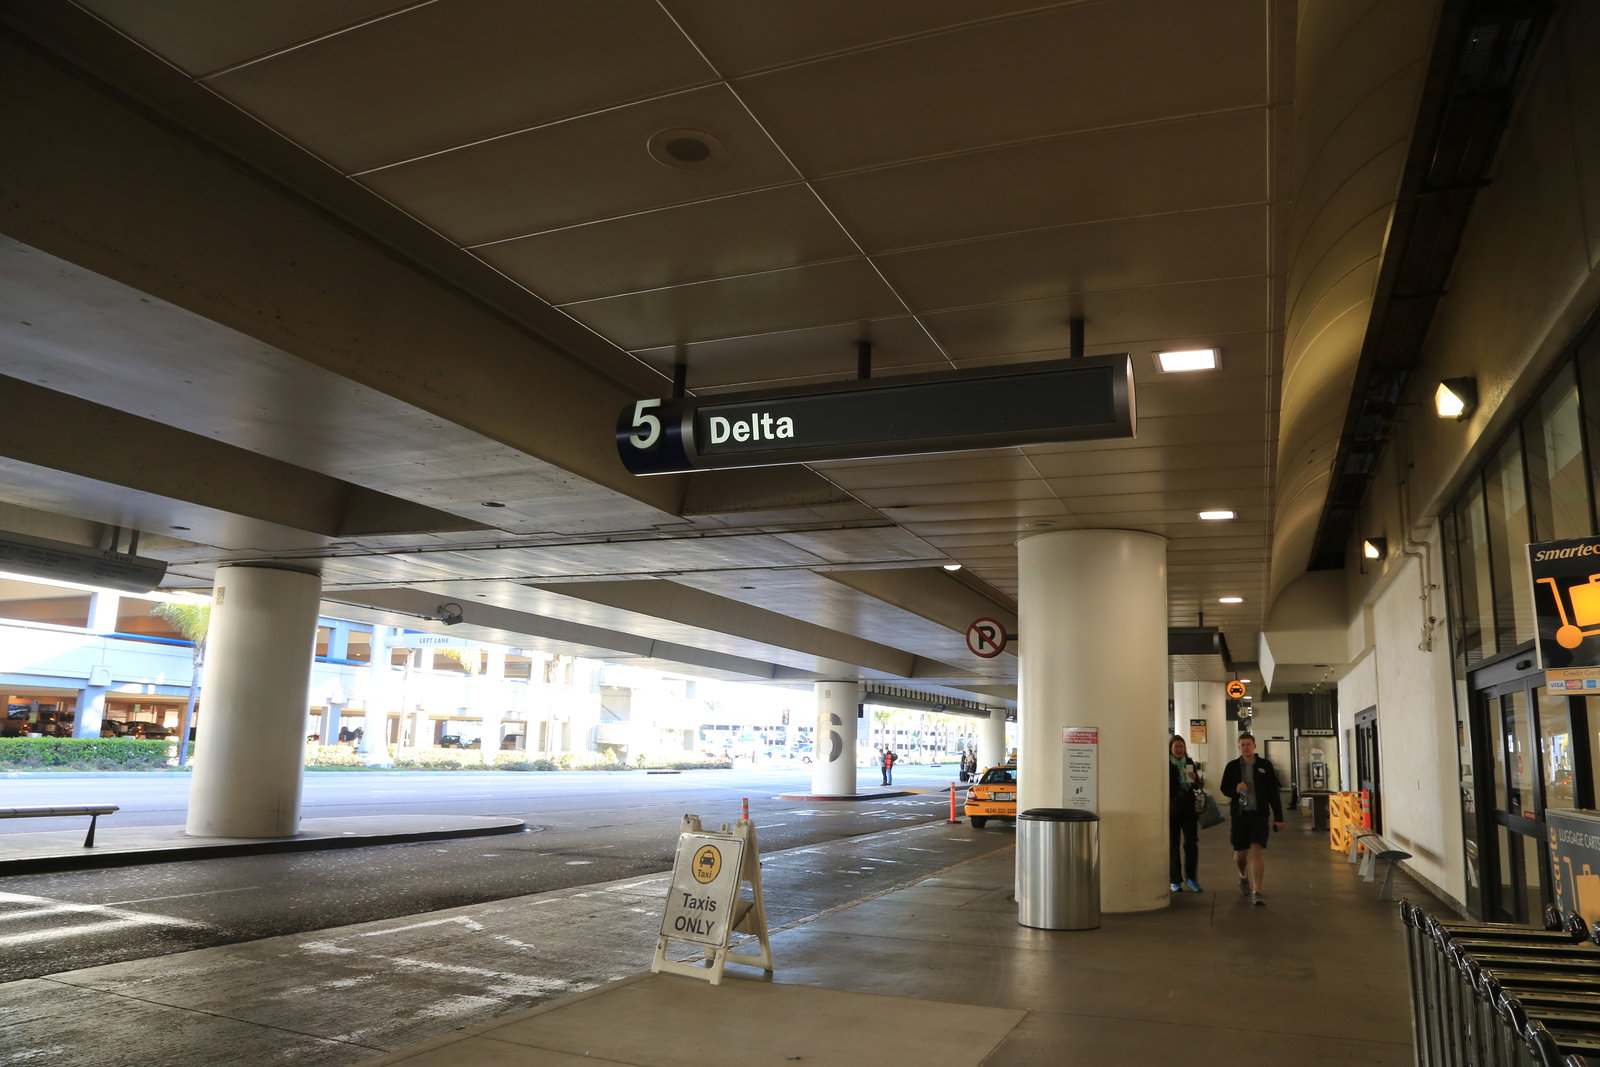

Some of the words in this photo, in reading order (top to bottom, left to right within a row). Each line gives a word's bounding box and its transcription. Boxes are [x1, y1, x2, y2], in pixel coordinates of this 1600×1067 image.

[630, 399, 661, 449] 5
[710, 413, 794, 444] Delta
[816, 712, 843, 763] 6
[1559, 828, 1584, 847] LUGGAGE
[697, 869, 712, 878] Taxi
[683, 893, 717, 912] Taxis
[675, 916, 715, 936] ONLY
